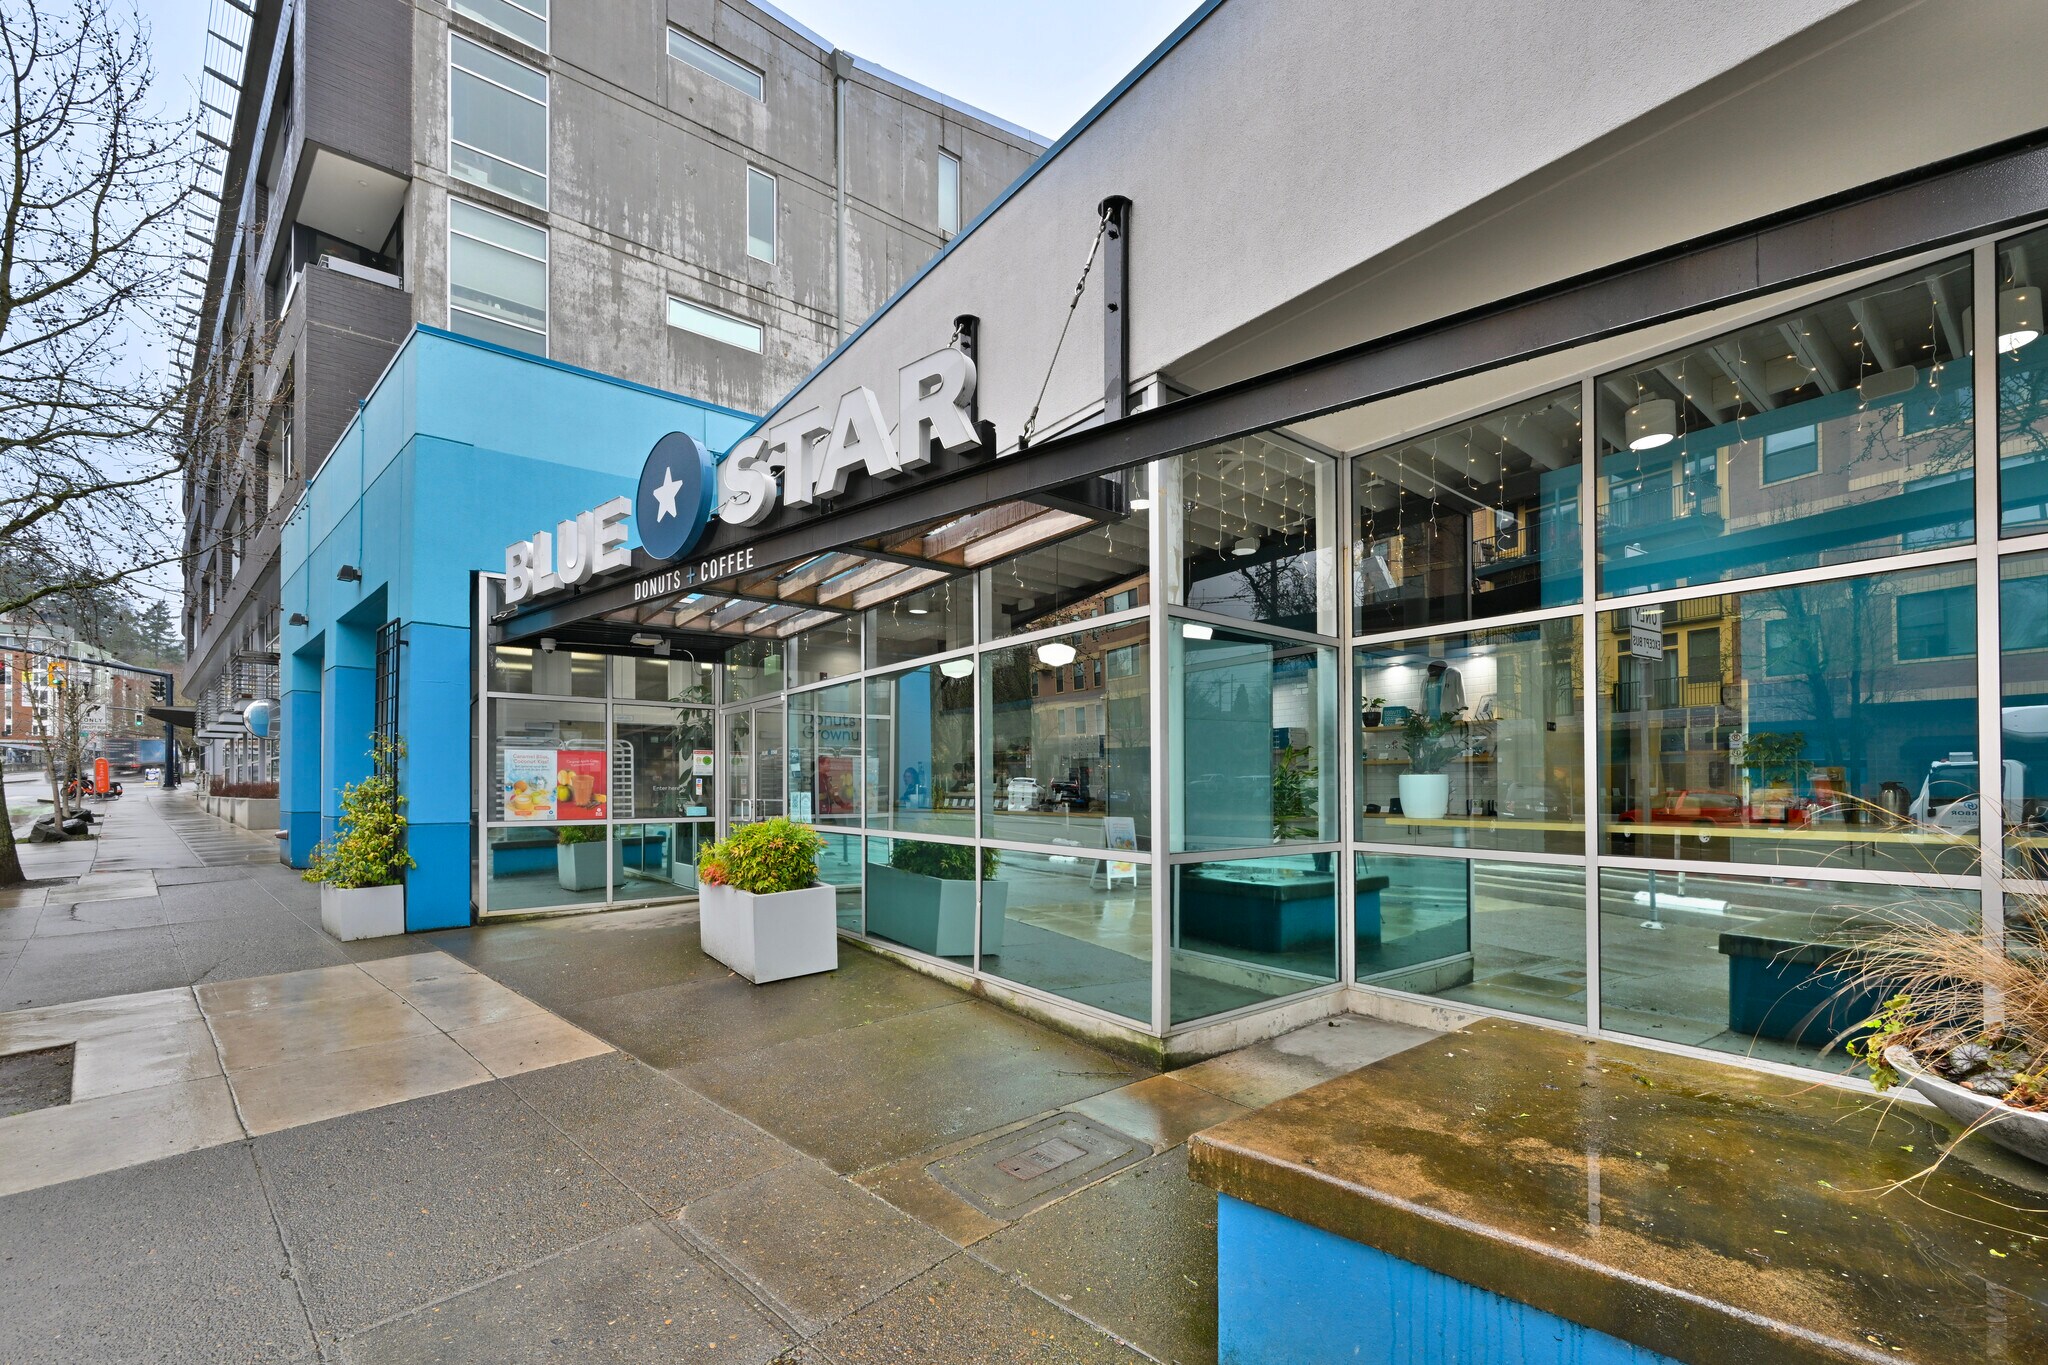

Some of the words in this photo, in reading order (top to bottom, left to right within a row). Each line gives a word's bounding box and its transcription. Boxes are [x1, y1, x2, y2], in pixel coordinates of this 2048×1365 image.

[505, 495, 632, 605] BLUE
[718, 347, 981, 527] STAR
[634, 570, 681, 601] DONUTS
[701, 547, 754, 582] COFFEE
[802, 726, 861, 742] Grownu
[803, 712, 856, 727] Donuts
